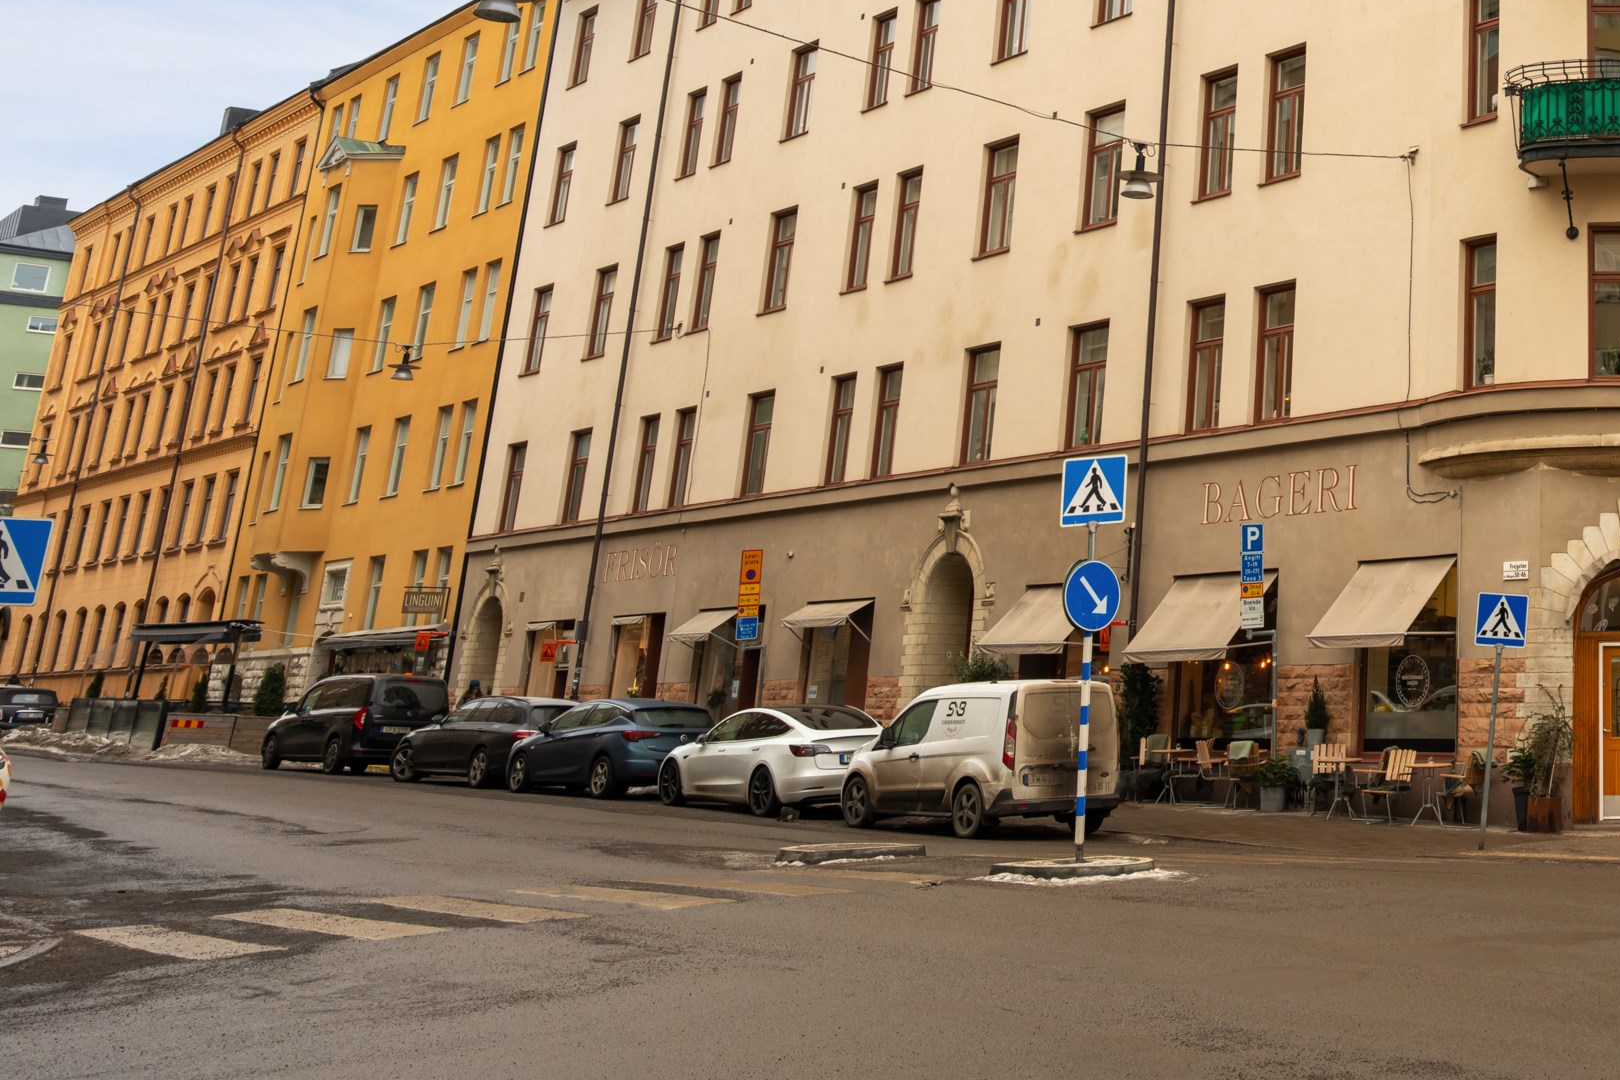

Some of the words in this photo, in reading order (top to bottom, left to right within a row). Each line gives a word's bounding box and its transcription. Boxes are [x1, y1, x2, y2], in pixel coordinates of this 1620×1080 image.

[1200, 464, 1358, 525] BAGERI
[1247, 526, 1260, 550] P
[602, 541, 678, 584] FRISÖR
[404, 594, 443, 607] LINGUINI
